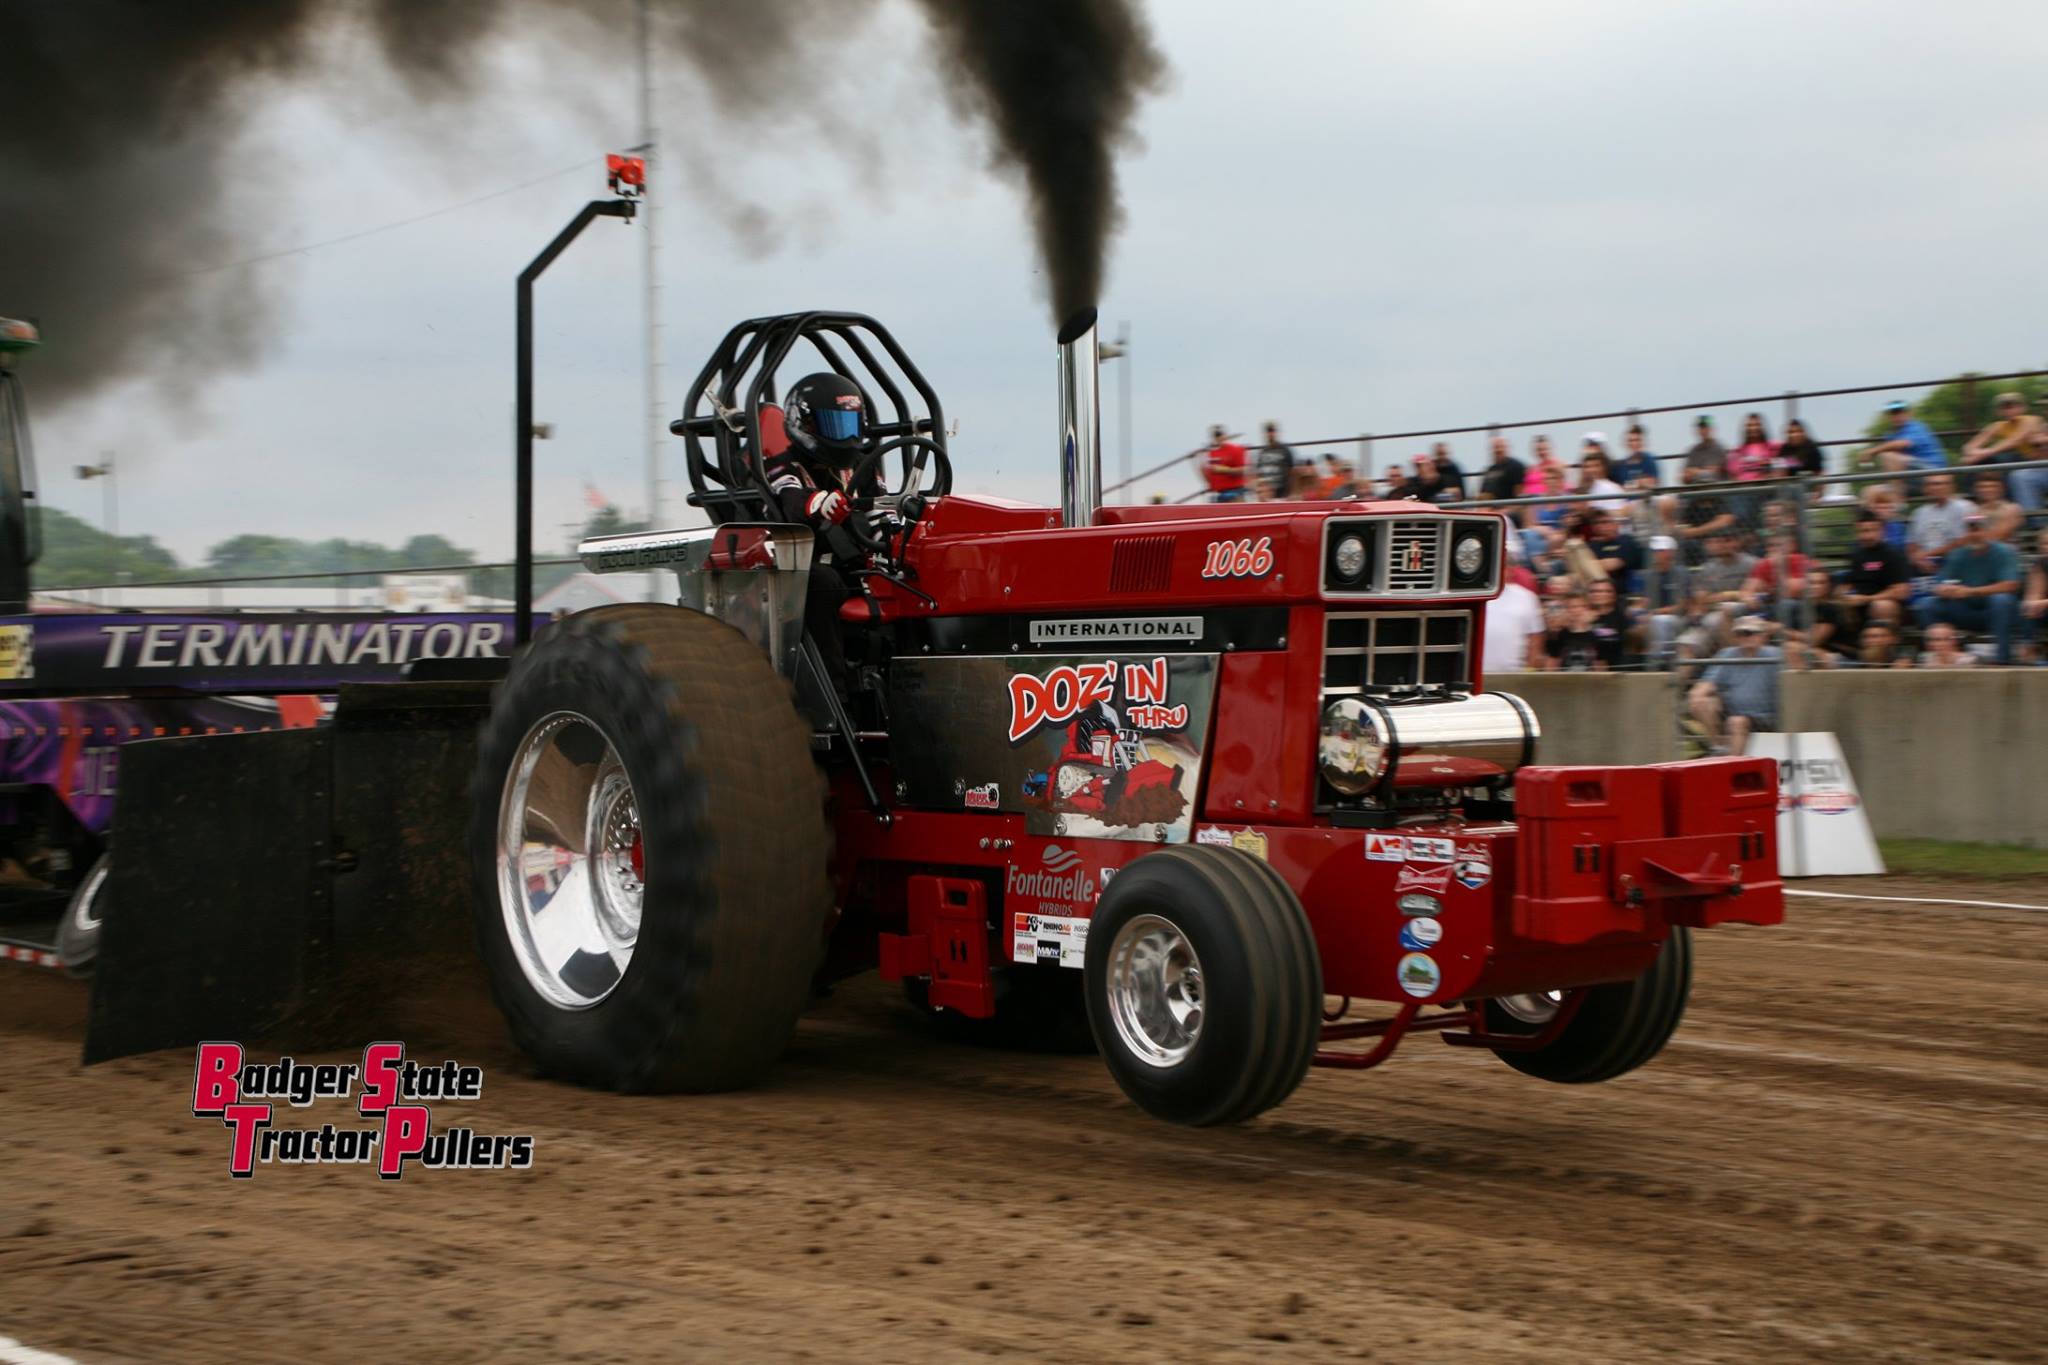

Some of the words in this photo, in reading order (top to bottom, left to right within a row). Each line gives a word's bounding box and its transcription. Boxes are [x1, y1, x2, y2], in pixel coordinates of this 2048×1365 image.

[1201, 536, 1273, 577] 1066
[1037, 622, 1195, 636] INTERNATIONAL
[101, 622, 503, 669] TERMINATOR
[1127, 704, 1188, 729] THRU
[1007, 865, 1094, 902] Fontanelle
[1039, 902, 1073, 916] HYBRIDS
